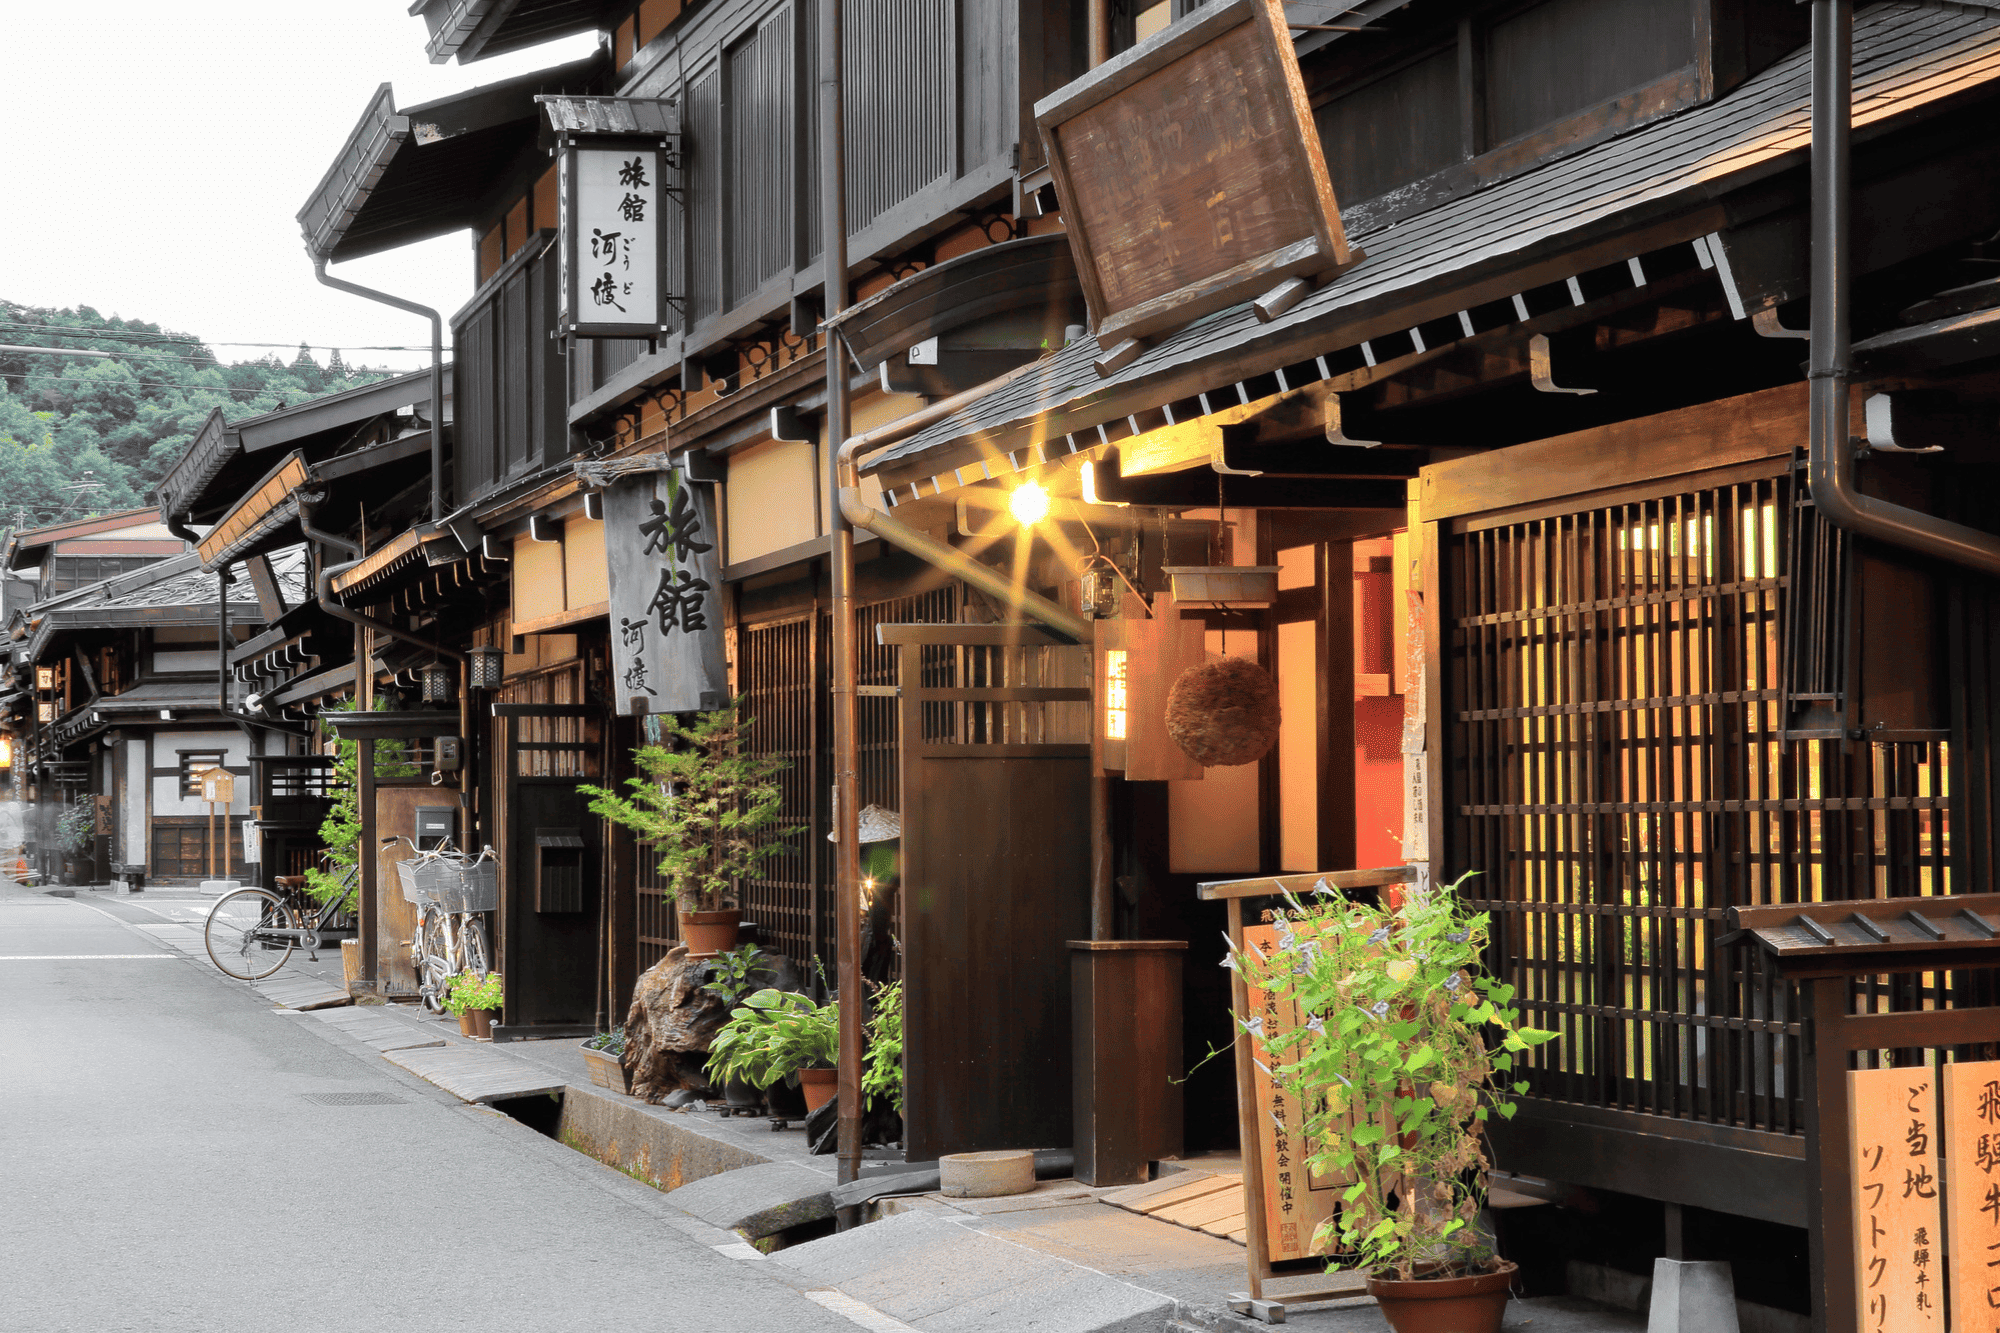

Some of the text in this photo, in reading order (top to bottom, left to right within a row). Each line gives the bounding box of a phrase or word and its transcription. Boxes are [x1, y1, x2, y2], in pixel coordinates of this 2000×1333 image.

[617, 155, 650, 223] 旅館
[622, 237, 637, 296] ごうど
[638, 485, 713, 637] 旅館
[1271, 1093, 1291, 1168] 無料試飲会
[1902, 1082, 1937, 1200] ご当地
[1278, 1171, 1294, 1216] 開催中
[1862, 1144, 1888, 1333] ソフトクリ
